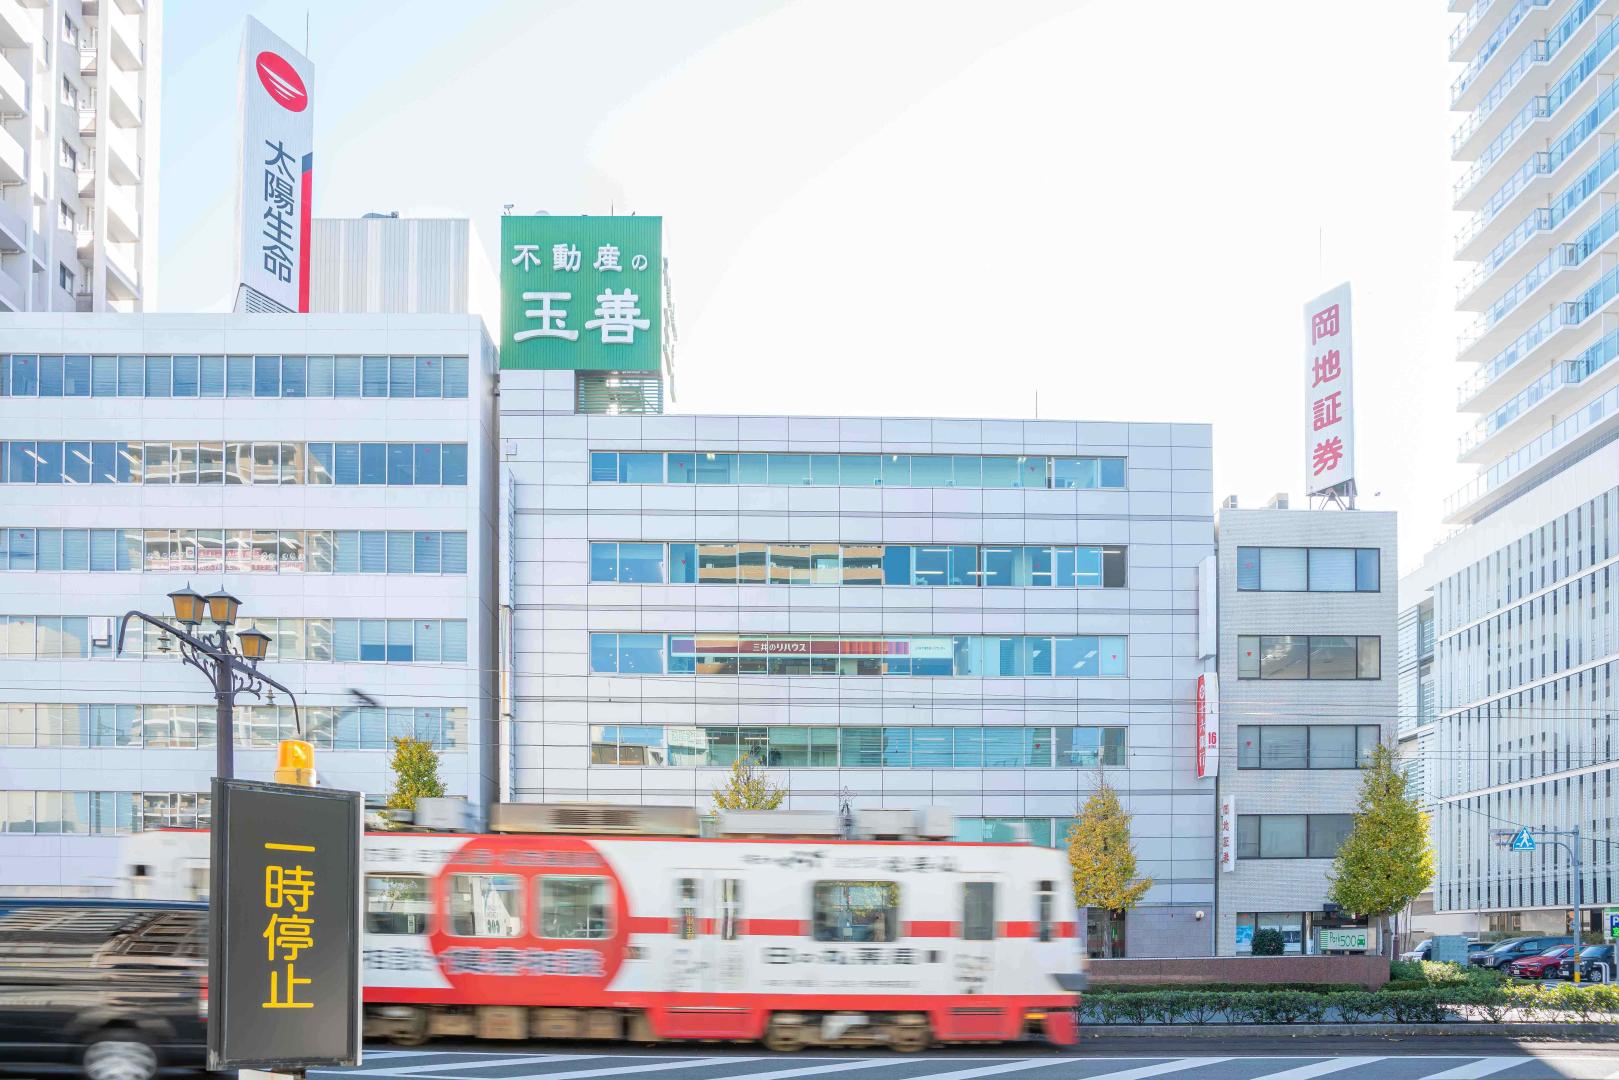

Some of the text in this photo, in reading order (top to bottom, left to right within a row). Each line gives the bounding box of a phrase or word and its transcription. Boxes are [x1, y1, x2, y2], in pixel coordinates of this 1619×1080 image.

[263, 139, 296, 284] 太陽生命
[511, 243, 648, 272] 不動産の
[513, 288, 651, 344] 玉善
[1312, 304, 1343, 477] 岡地証券
[752, 642, 807, 652] 三井のリハウス
[1208, 732, 1217, 745] 16
[262, 842, 316, 1009] 一時停止
